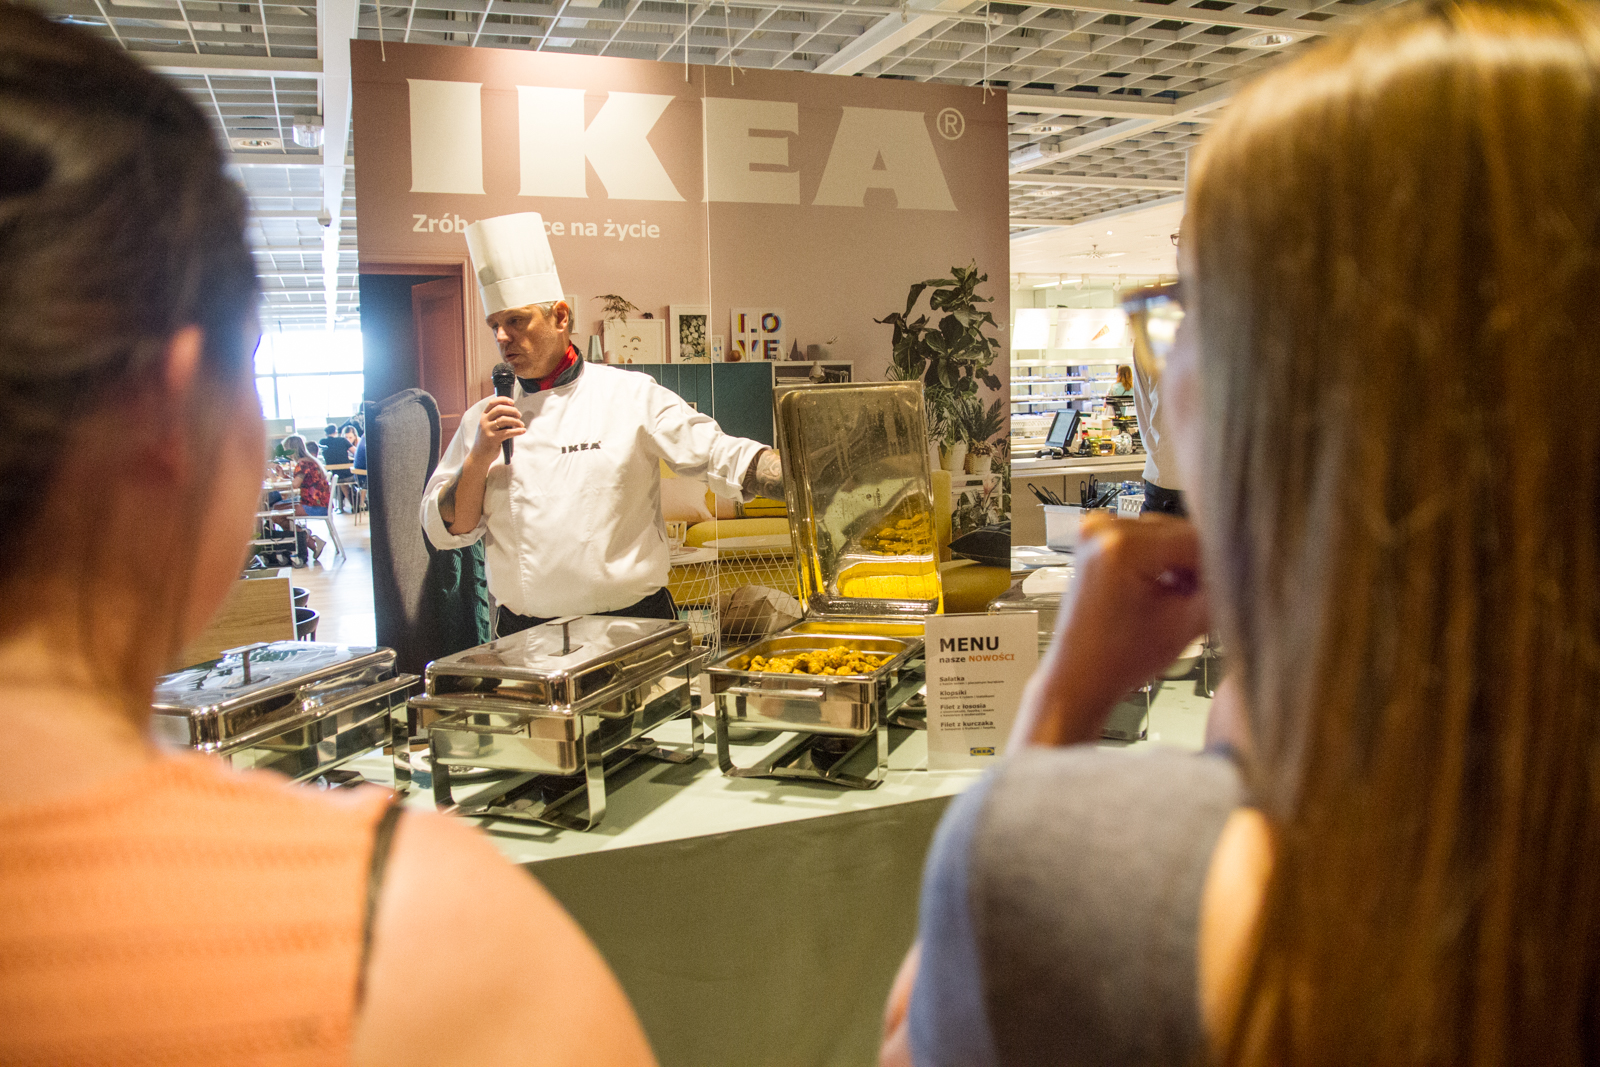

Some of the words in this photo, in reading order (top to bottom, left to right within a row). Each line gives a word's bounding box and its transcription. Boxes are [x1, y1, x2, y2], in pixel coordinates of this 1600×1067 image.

[412, 213, 467, 233] Zrób
[571, 222, 598, 236] na
[604, 219, 660, 241] życie
[561, 442, 601, 454] IKEA
[940, 636, 999, 652] MENU
[968, 652, 1015, 662] NOWOŚCI
